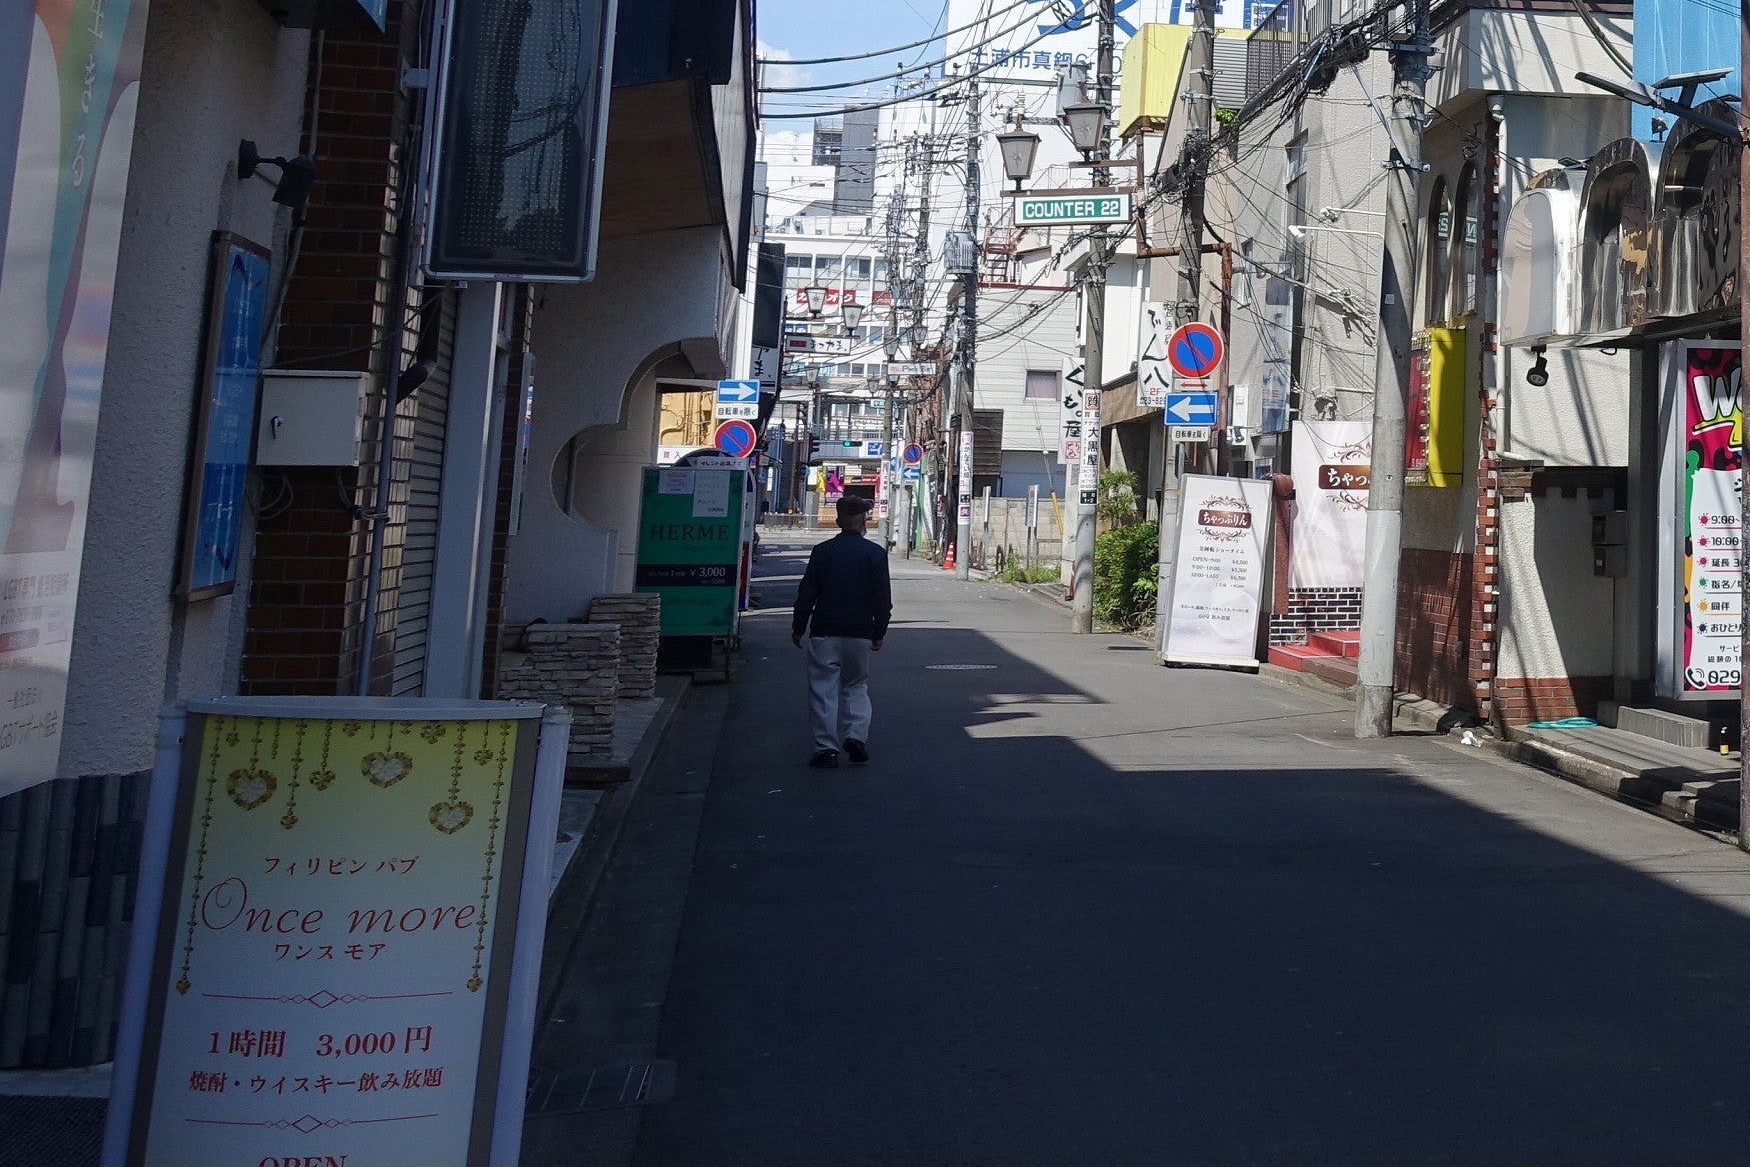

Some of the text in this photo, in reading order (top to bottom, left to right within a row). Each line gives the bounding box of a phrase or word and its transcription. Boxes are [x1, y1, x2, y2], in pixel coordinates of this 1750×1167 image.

[1025, 200, 1119, 218] COUNTER 22
[1327, 467, 1371, 487] ちゃっ
[1710, 601, 1730, 611] 同伴
[200, 876, 475, 934] Once more
[188, 1066, 443, 1096] 焼酎・ウイスキー飲み放題
